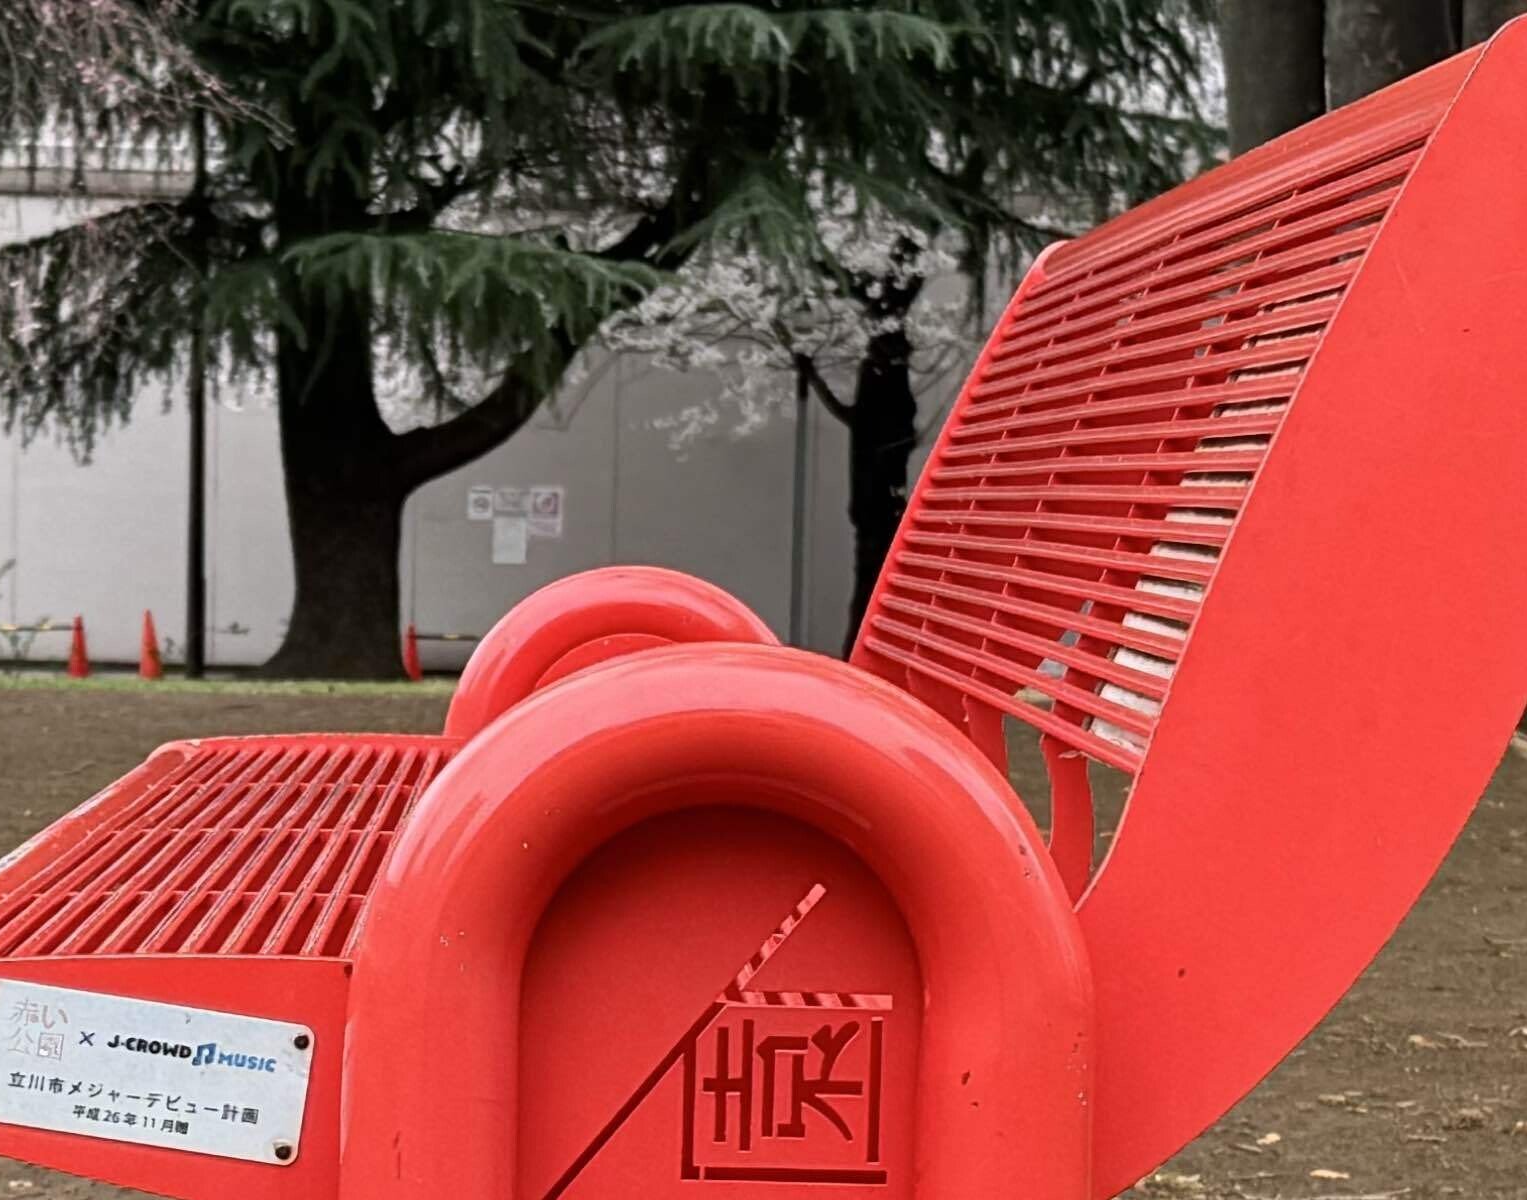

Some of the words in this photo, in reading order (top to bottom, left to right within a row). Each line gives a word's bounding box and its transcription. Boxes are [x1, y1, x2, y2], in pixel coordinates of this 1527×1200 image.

[218, 1052, 278, 1073] MUSIC
[8, 1071, 260, 1124] 立川市メジャーデビュー計画
